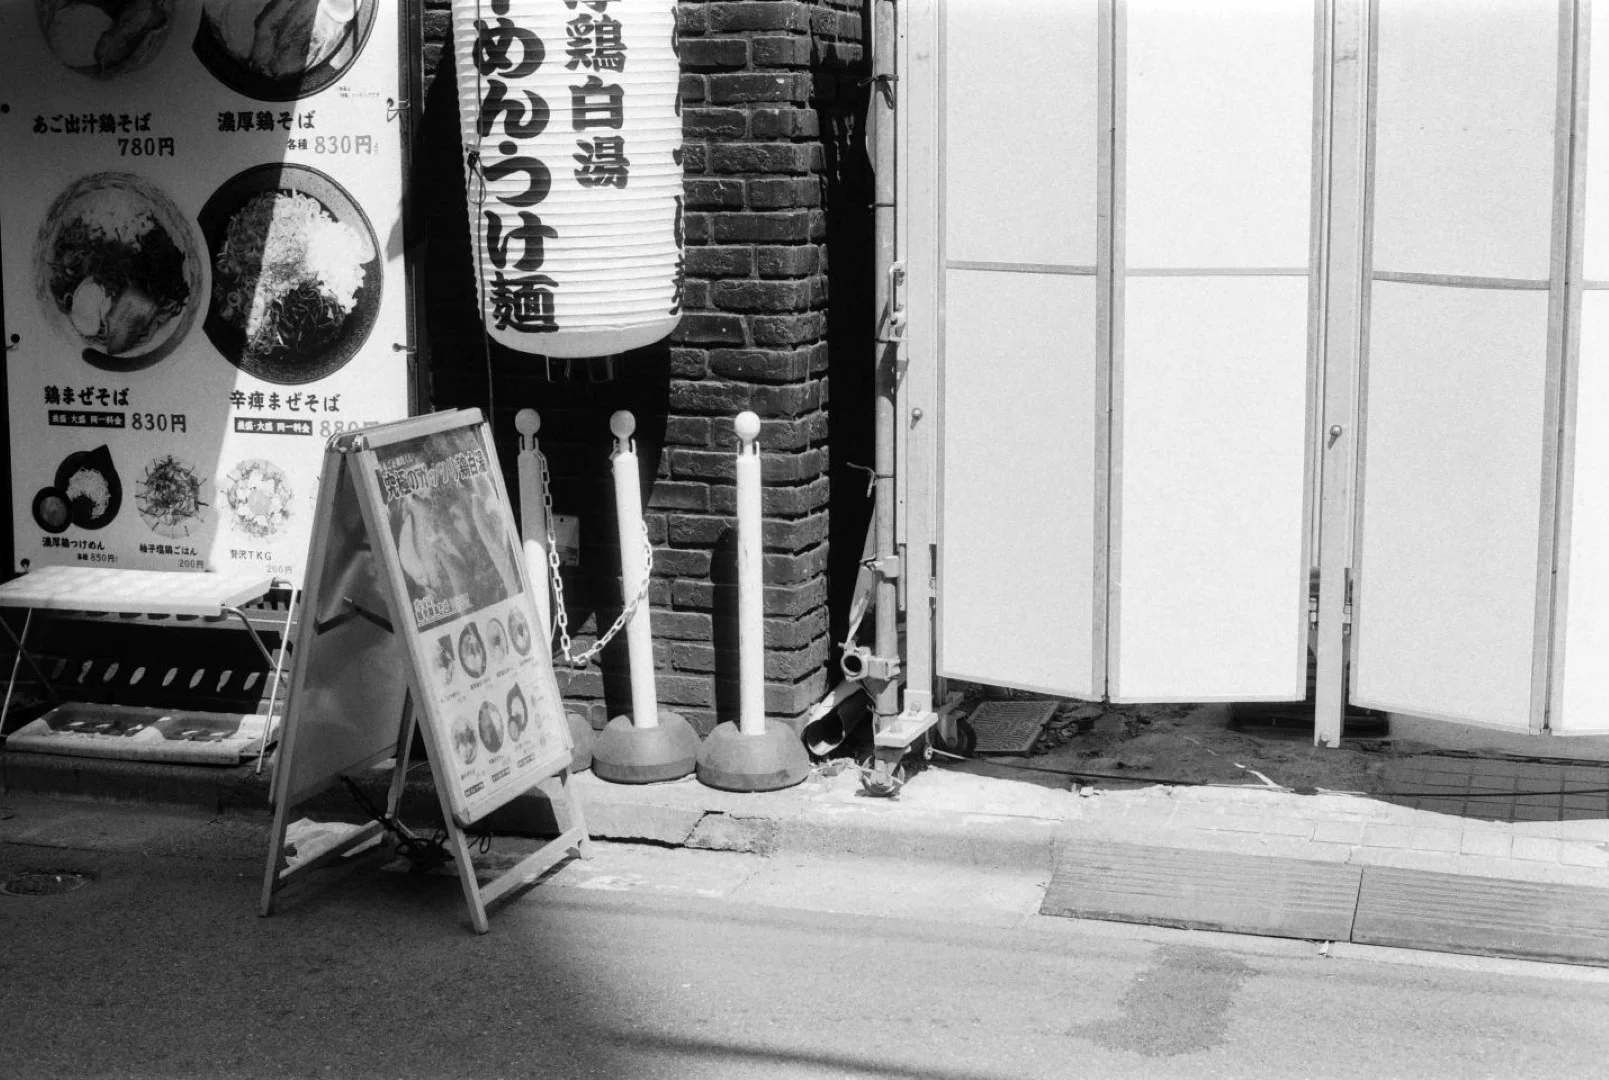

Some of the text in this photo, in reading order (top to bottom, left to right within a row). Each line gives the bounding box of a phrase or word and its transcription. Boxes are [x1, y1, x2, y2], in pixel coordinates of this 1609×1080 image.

[563, 0, 631, 190] 鶏白湯
[32, 112, 152, 134] あご出汁鶏そば
[217, 110, 316, 132] 濃厚鶏そば
[117, 137, 175, 157] 780円
[287, 138, 308, 150] 各種
[315, 134, 372, 155] 830円
[44, 385, 130, 406] 鶏まぜそば
[229, 389, 341, 413] 辛痺まぜそば
[131, 412, 187, 434] 830円
[319, 420, 380, 438] 880
[178, 559, 205, 569] 200円
